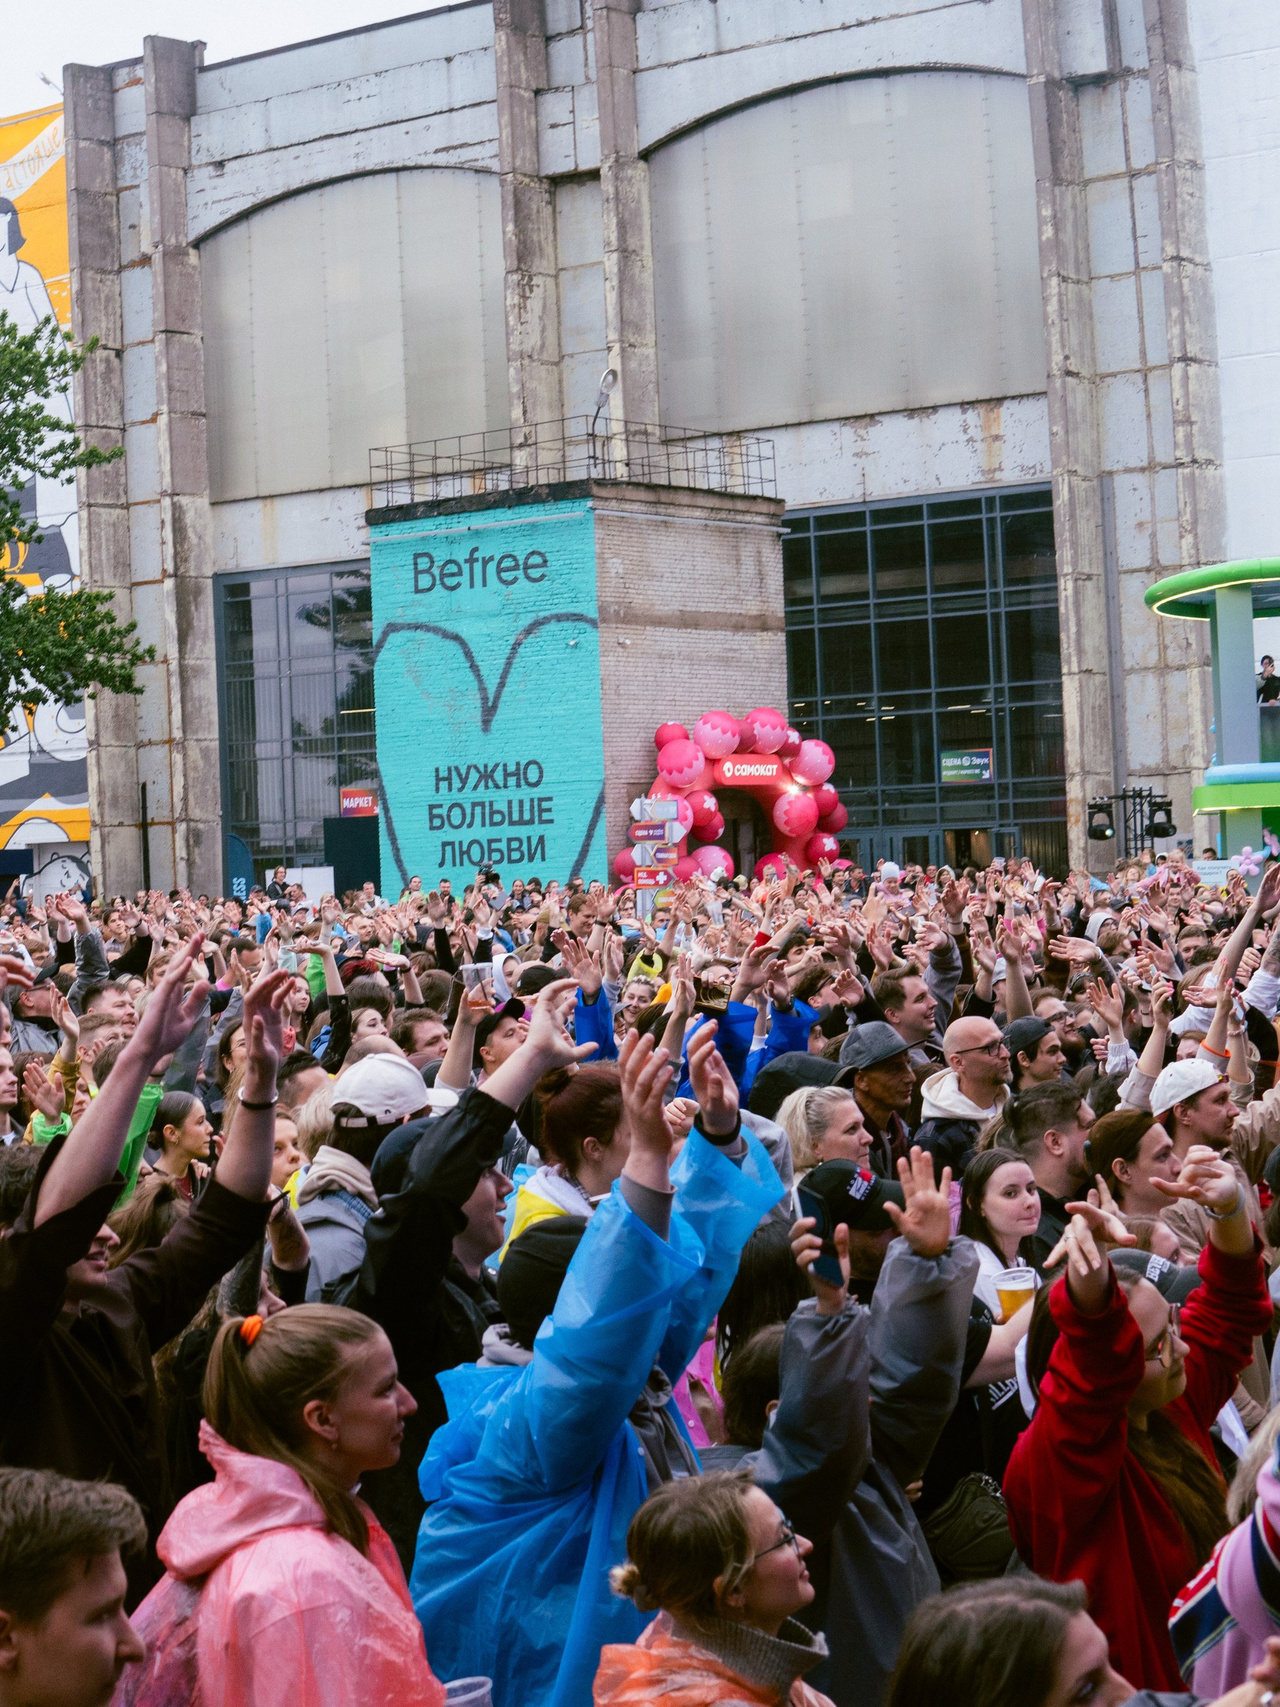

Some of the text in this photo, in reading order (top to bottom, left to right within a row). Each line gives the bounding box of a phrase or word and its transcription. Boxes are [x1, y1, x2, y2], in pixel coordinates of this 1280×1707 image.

[413, 546, 548, 594] Befree
[434, 759, 544, 794] НУЖНО
[343, 796, 373, 808] МАРКЕТ
[428, 796, 554, 831] БОЛЬШЕ
[438, 834, 546, 868] ЛЮБВИ
